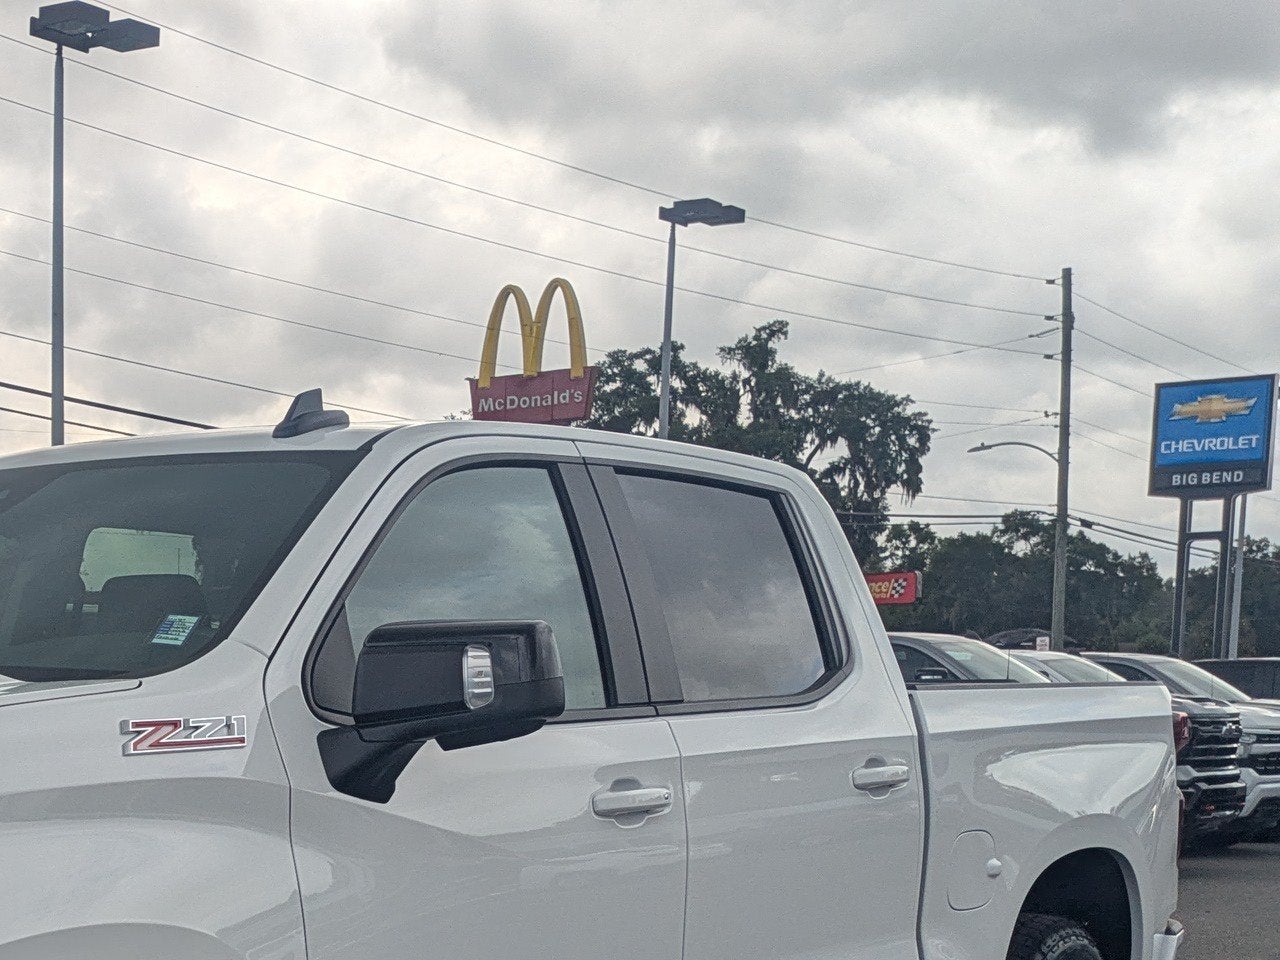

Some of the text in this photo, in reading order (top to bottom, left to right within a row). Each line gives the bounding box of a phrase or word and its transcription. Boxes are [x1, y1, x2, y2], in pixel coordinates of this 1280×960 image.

[478, 389, 583, 413] McDonald's
[1160, 434, 1260, 454] CHEVROLET
[1171, 470, 1244, 486] BIG BEND
[121, 713, 247, 755] Z71
